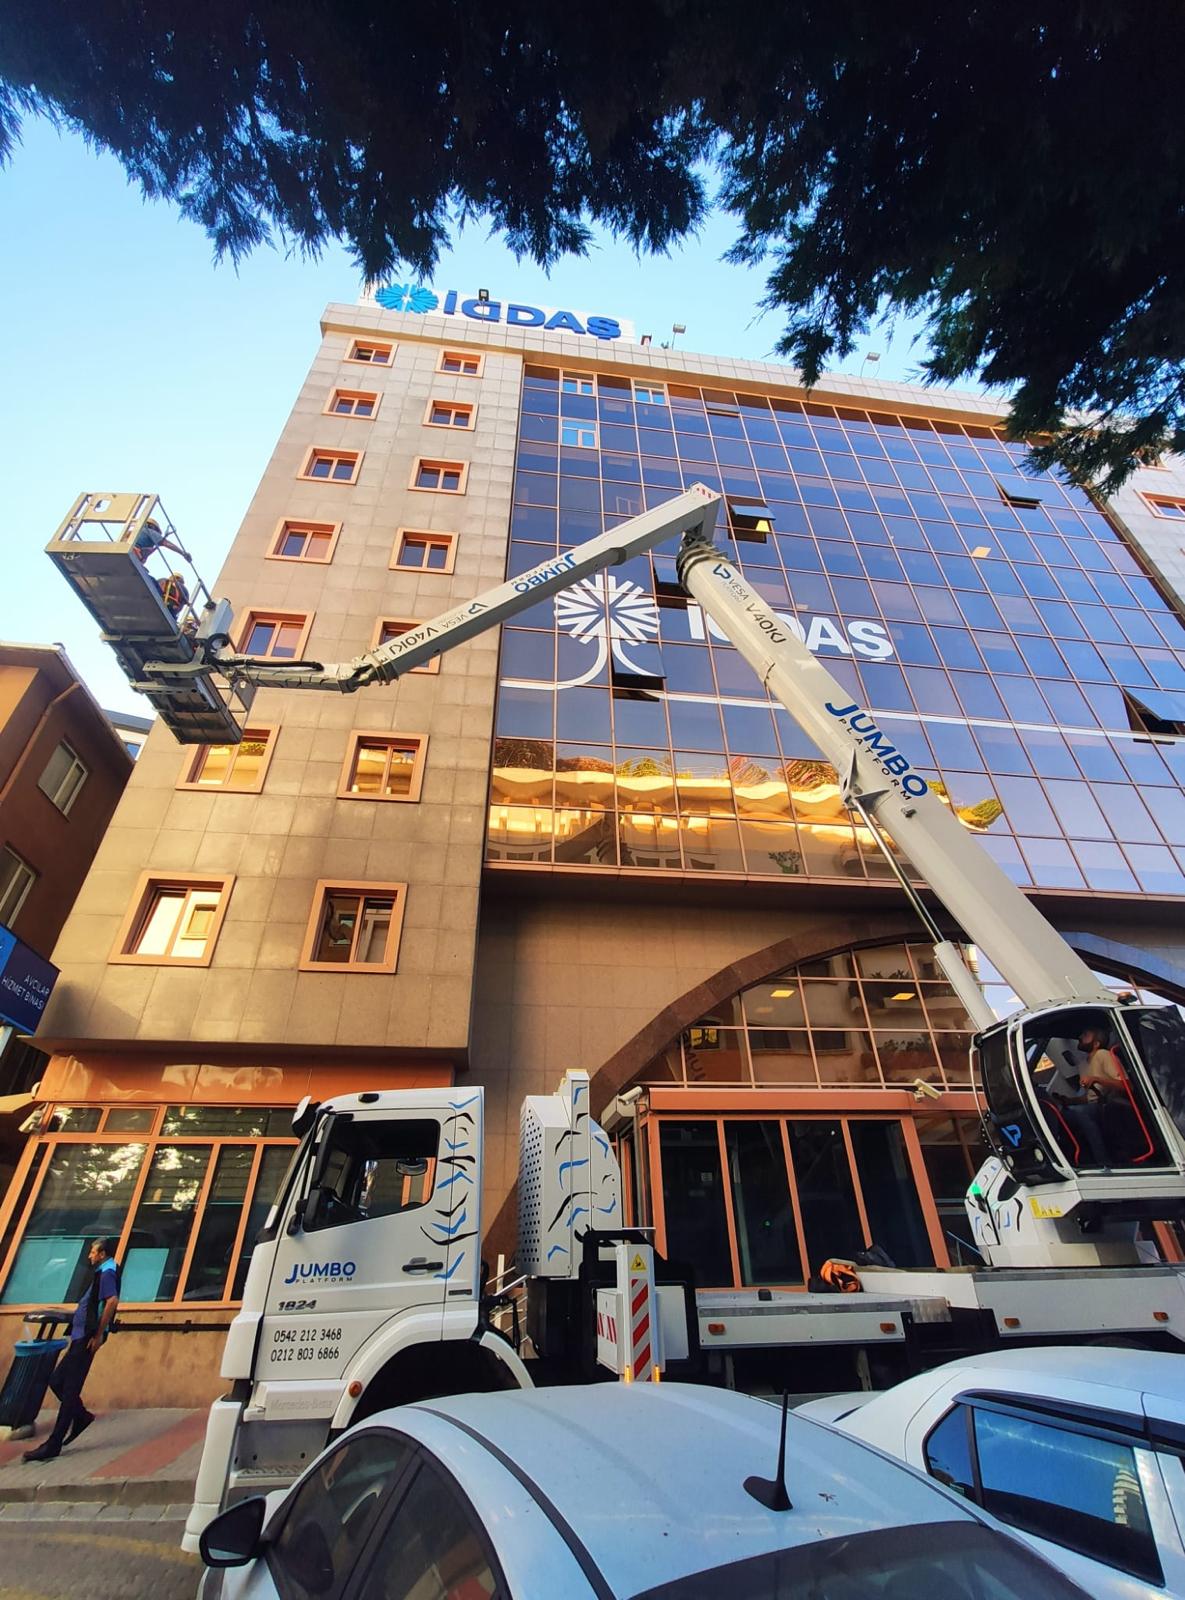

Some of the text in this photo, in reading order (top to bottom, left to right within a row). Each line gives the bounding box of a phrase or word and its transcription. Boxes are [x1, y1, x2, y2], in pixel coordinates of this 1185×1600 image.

[514, 553, 577, 592] JUMBO
[728, 579, 749, 600] VESA
[442, 613, 468, 629] VESA
[824, 702, 928, 797] JUMBO
[838, 718, 912, 801] PLATFORM
[284, 1261, 356, 1285] JUMBO
[278, 1300, 317, 1311] 1824
[273, 1328, 342, 1343] 0542 212 3468
[270, 1347, 339, 1362] 0212 803 6866
